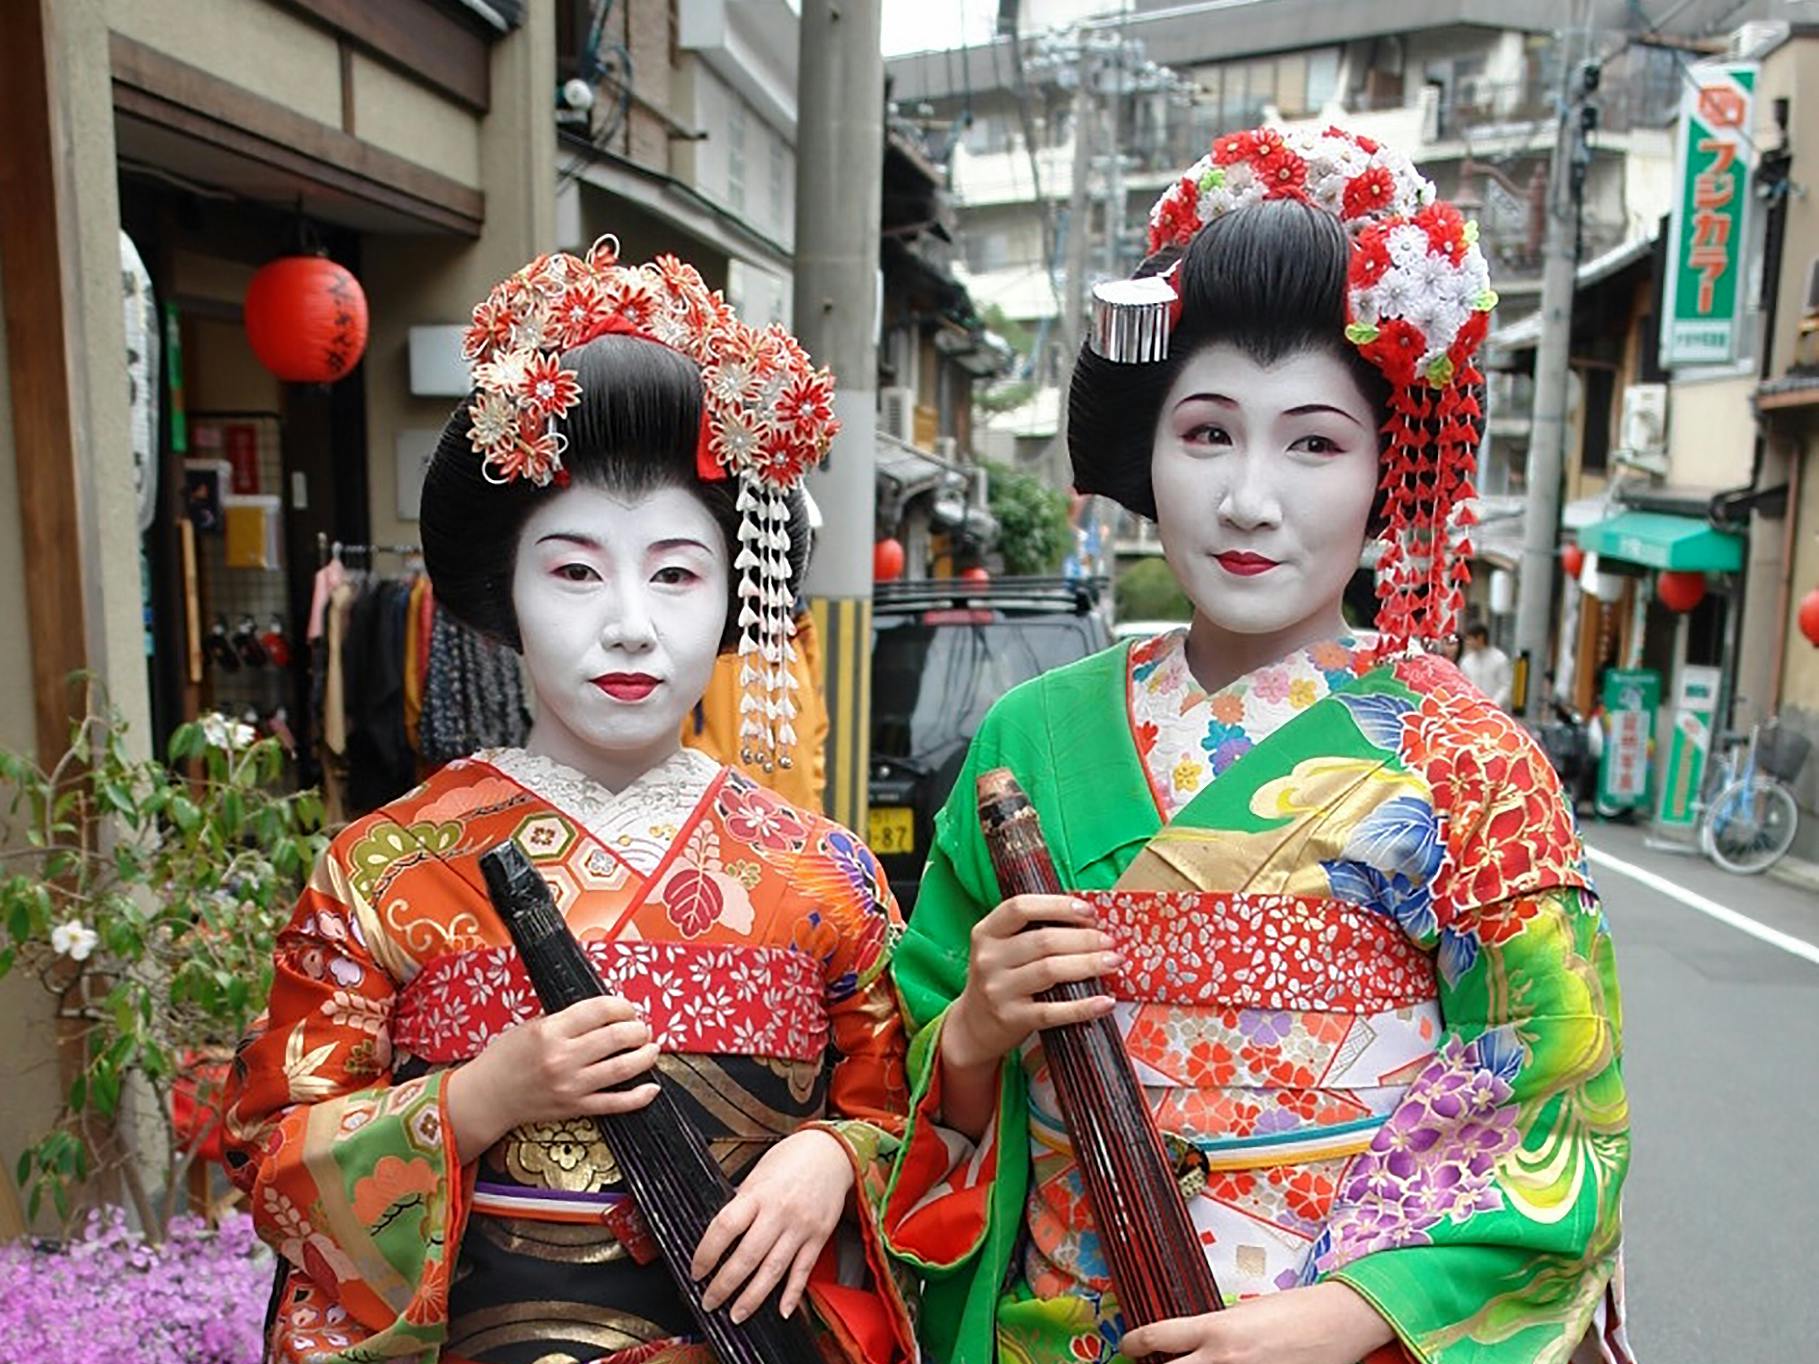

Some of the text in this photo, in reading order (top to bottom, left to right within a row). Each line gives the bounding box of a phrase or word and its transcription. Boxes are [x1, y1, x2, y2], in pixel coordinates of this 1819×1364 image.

[1689, 140, 1738, 314] フジカラー
